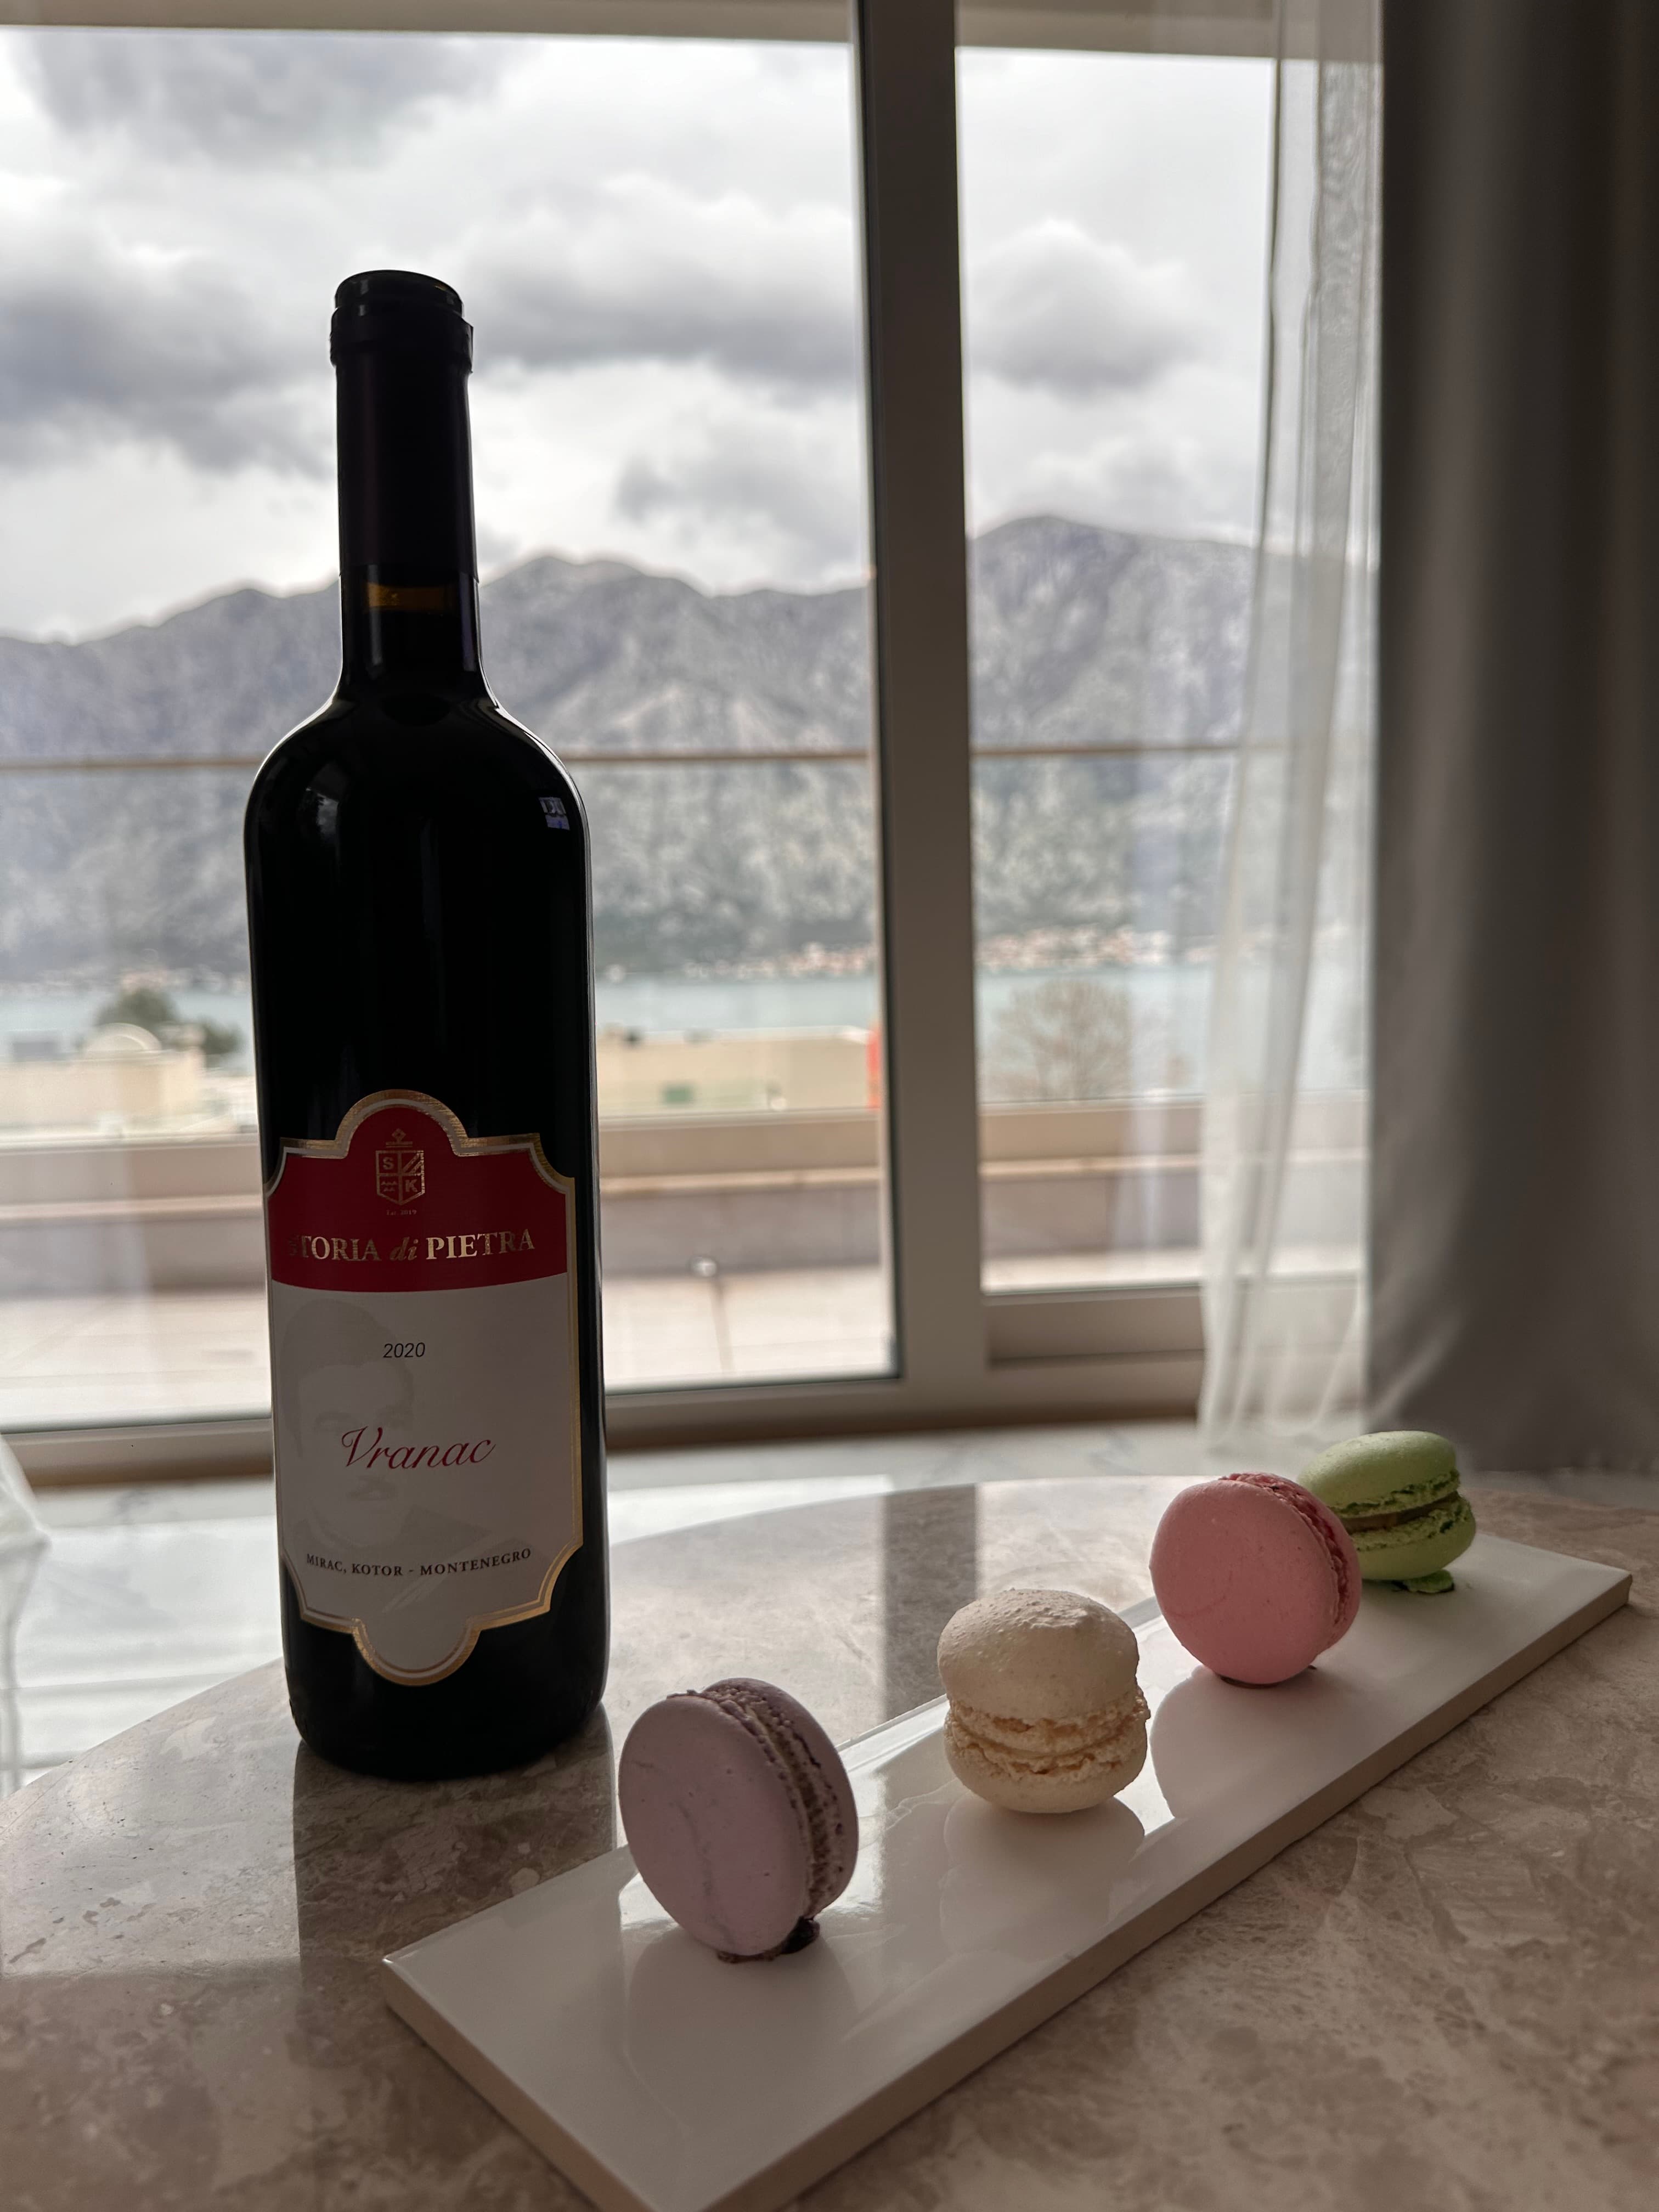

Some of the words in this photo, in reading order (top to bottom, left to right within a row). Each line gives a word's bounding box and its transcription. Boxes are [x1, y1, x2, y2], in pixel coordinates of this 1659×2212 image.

[382, 1156, 394, 1170] S
[405, 1179, 418, 1192] K
[389, 1237, 418, 1261] di
[426, 1229, 535, 1260] PIETRA
[383, 1342, 425, 1358] 2020
[342, 1426, 495, 1469] Vranac
[306, 1553, 347, 1574] MIRAC,
[352, 1563, 403, 1576] KOTOR
[420, 1548, 531, 1576] MONTENEGRO
